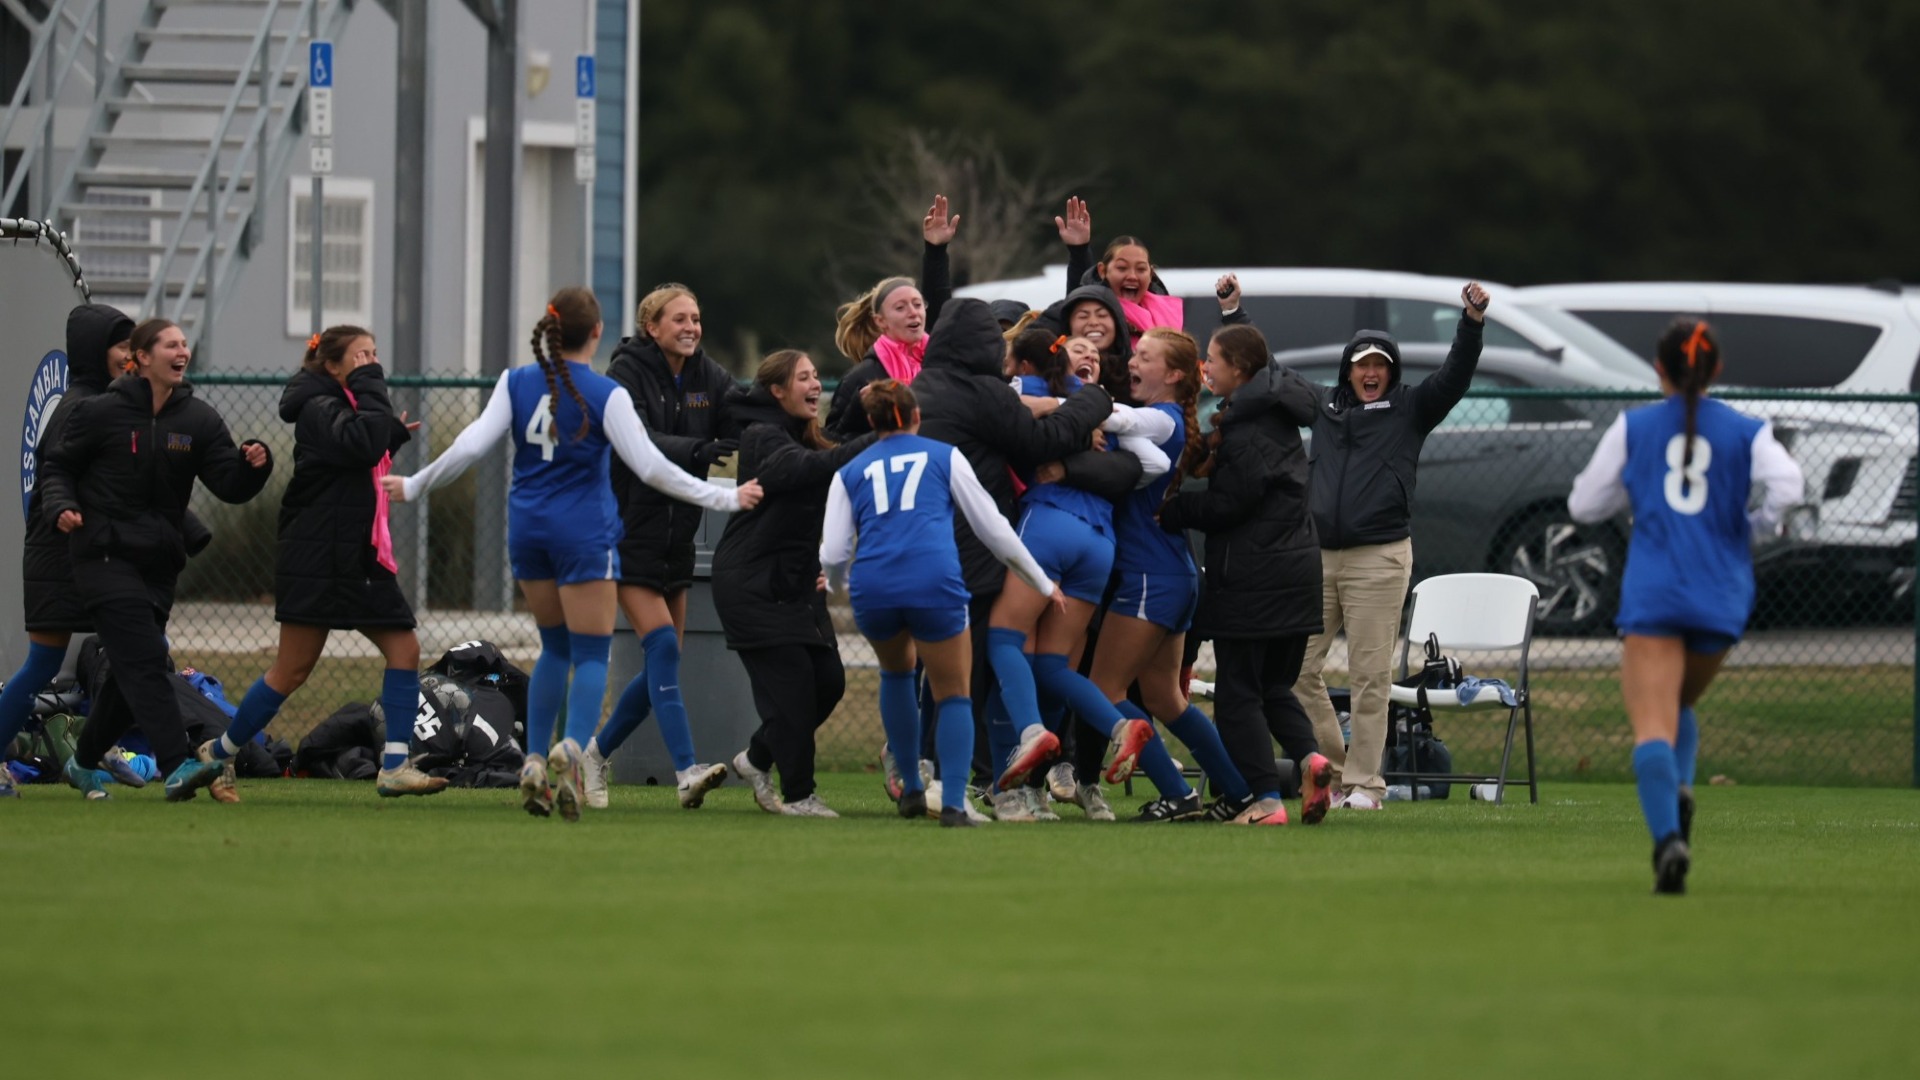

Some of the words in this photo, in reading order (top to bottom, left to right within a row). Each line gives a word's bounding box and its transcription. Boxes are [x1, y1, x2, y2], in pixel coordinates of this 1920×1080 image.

[23, 357, 61, 493] ESCAMBIA
[525, 393, 559, 462] 4
[863, 451, 928, 515] 17
[1663, 432, 1712, 516] 8
